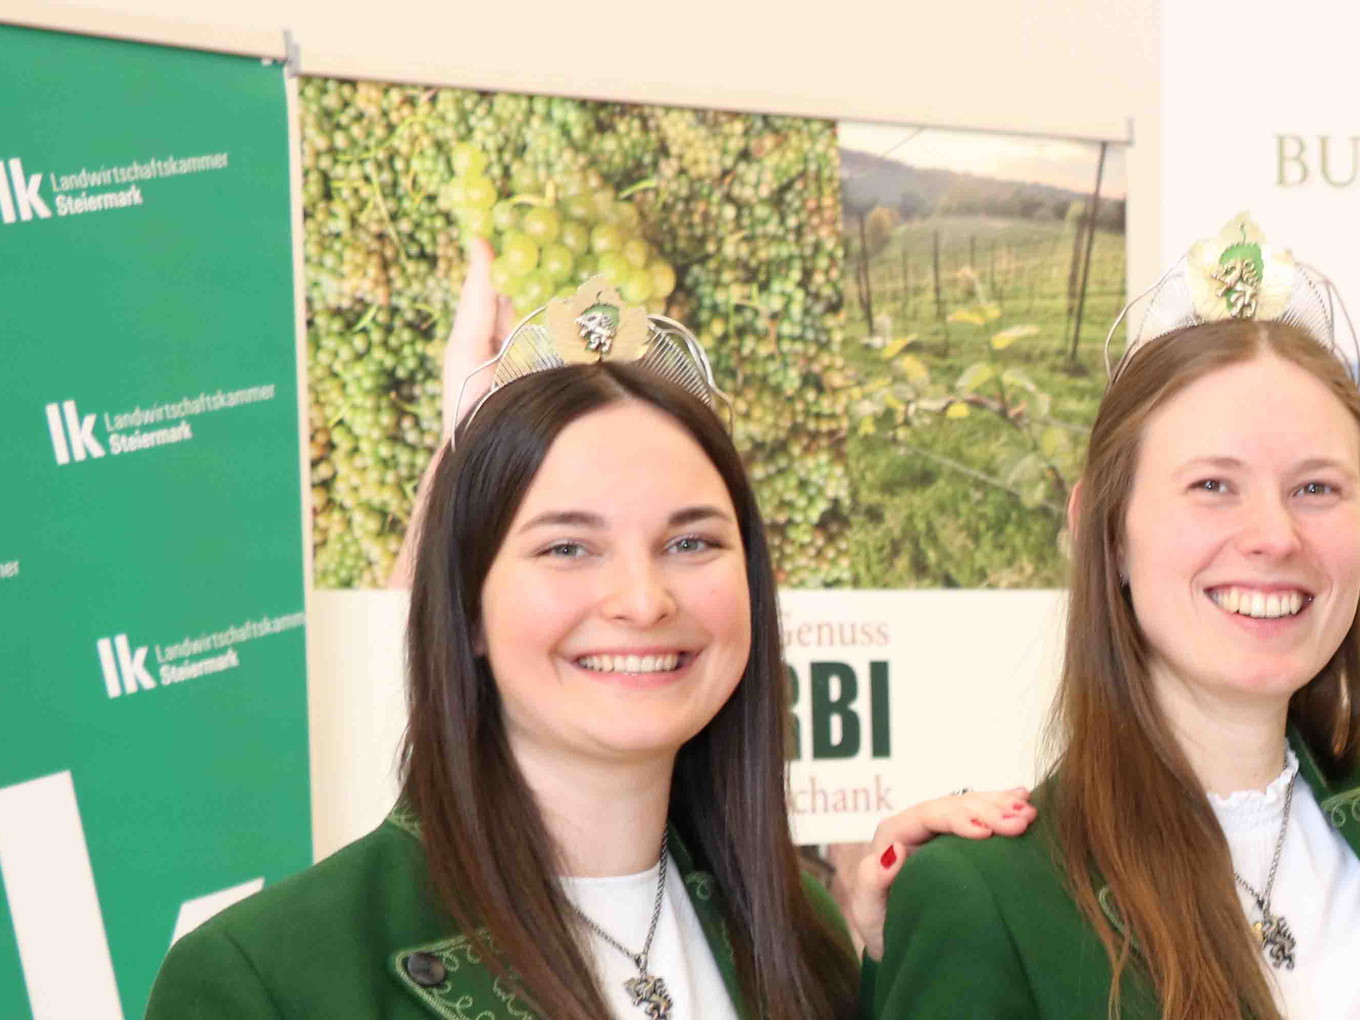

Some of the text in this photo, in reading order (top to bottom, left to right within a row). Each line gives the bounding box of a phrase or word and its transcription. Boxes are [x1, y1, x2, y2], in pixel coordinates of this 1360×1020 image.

[50, 152, 229, 193] Landwirtschaftskammer
[55, 185, 144, 217] Steiermark
[45, 384, 276, 466] lk Landwirtschaftskammer
[109, 419, 193, 456] Steiermark
[96, 632, 158, 700] lk
[158, 647, 240, 687] Steiermark
